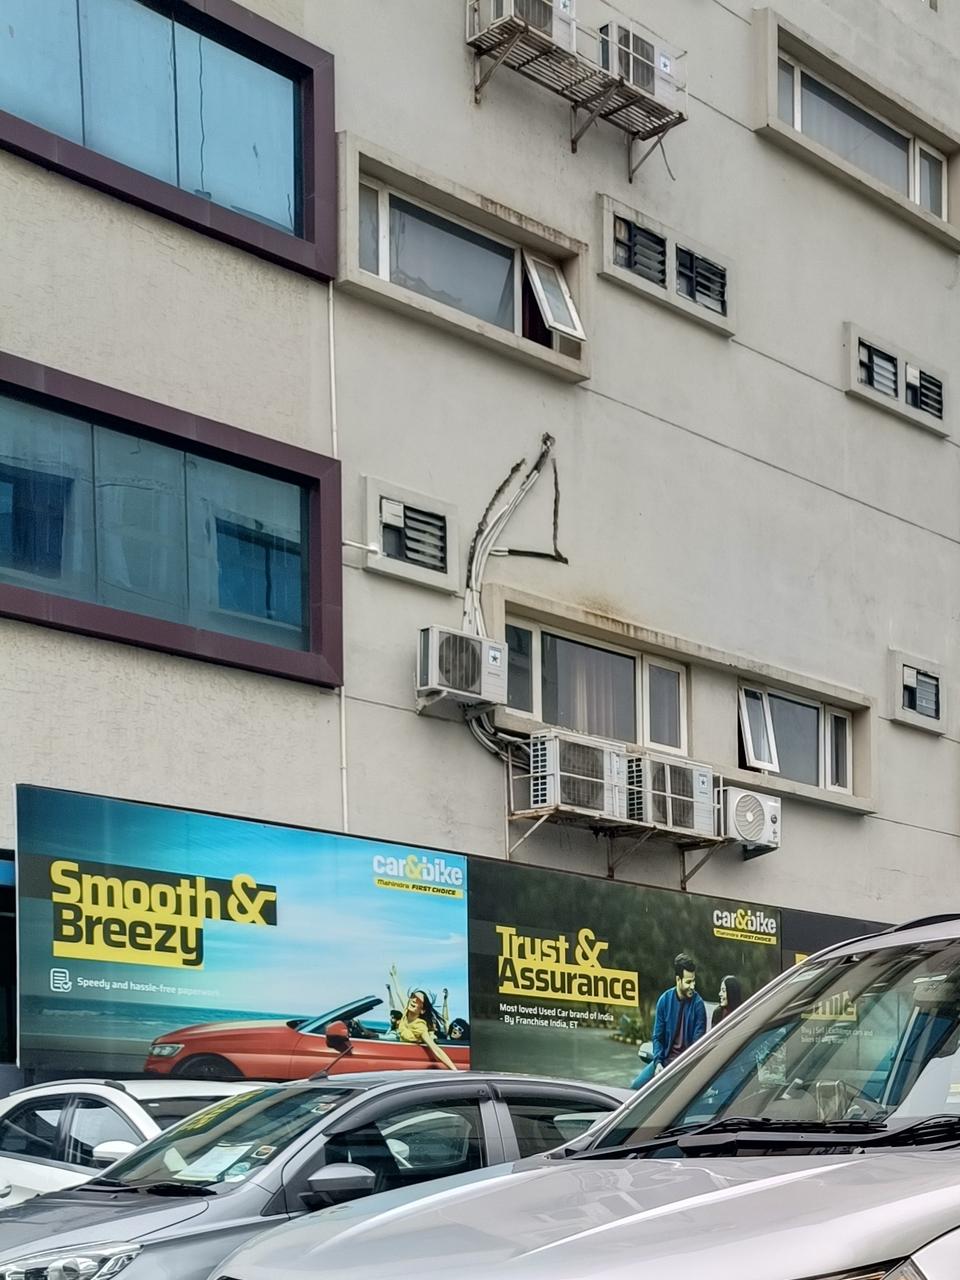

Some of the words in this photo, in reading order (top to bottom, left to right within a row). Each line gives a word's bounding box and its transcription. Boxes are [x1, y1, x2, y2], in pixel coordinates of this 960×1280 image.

[373, 855, 463, 885] car&bike
[51, 861, 221, 920] Smooth
[227, 873, 277, 925] &
[377, 879, 410, 889] Mahindra
[411, 884, 431, 893] FIRST
[432, 887, 457, 896] CHOICE
[53, 903, 204, 966] Breezy
[713, 908, 777, 934] car&bike
[496, 925, 570, 966] Trust
[575, 928, 609, 968] &
[77, 977, 110, 990] Speedy
[111, 981, 129, 990] and
[130, 982, 177, 994] hassle-free
[499, 957, 636, 1001] Assurance
[499, 1003, 517, 1013] Most
[519, 1005, 538, 1014] loved
[538, 1007, 556, 1016] Used
[557, 1009, 568, 1017] Car
[570, 1010, 589, 1019] brand
[590, 1012, 597, 1020] of
[598, 1013, 614, 1021] India
[504, 1015, 514, 1025] By
[515, 1016, 549, 1027] Franchise
[550, 1019, 569, 1029] India,
[570, 1021, 579, 1029] ET
